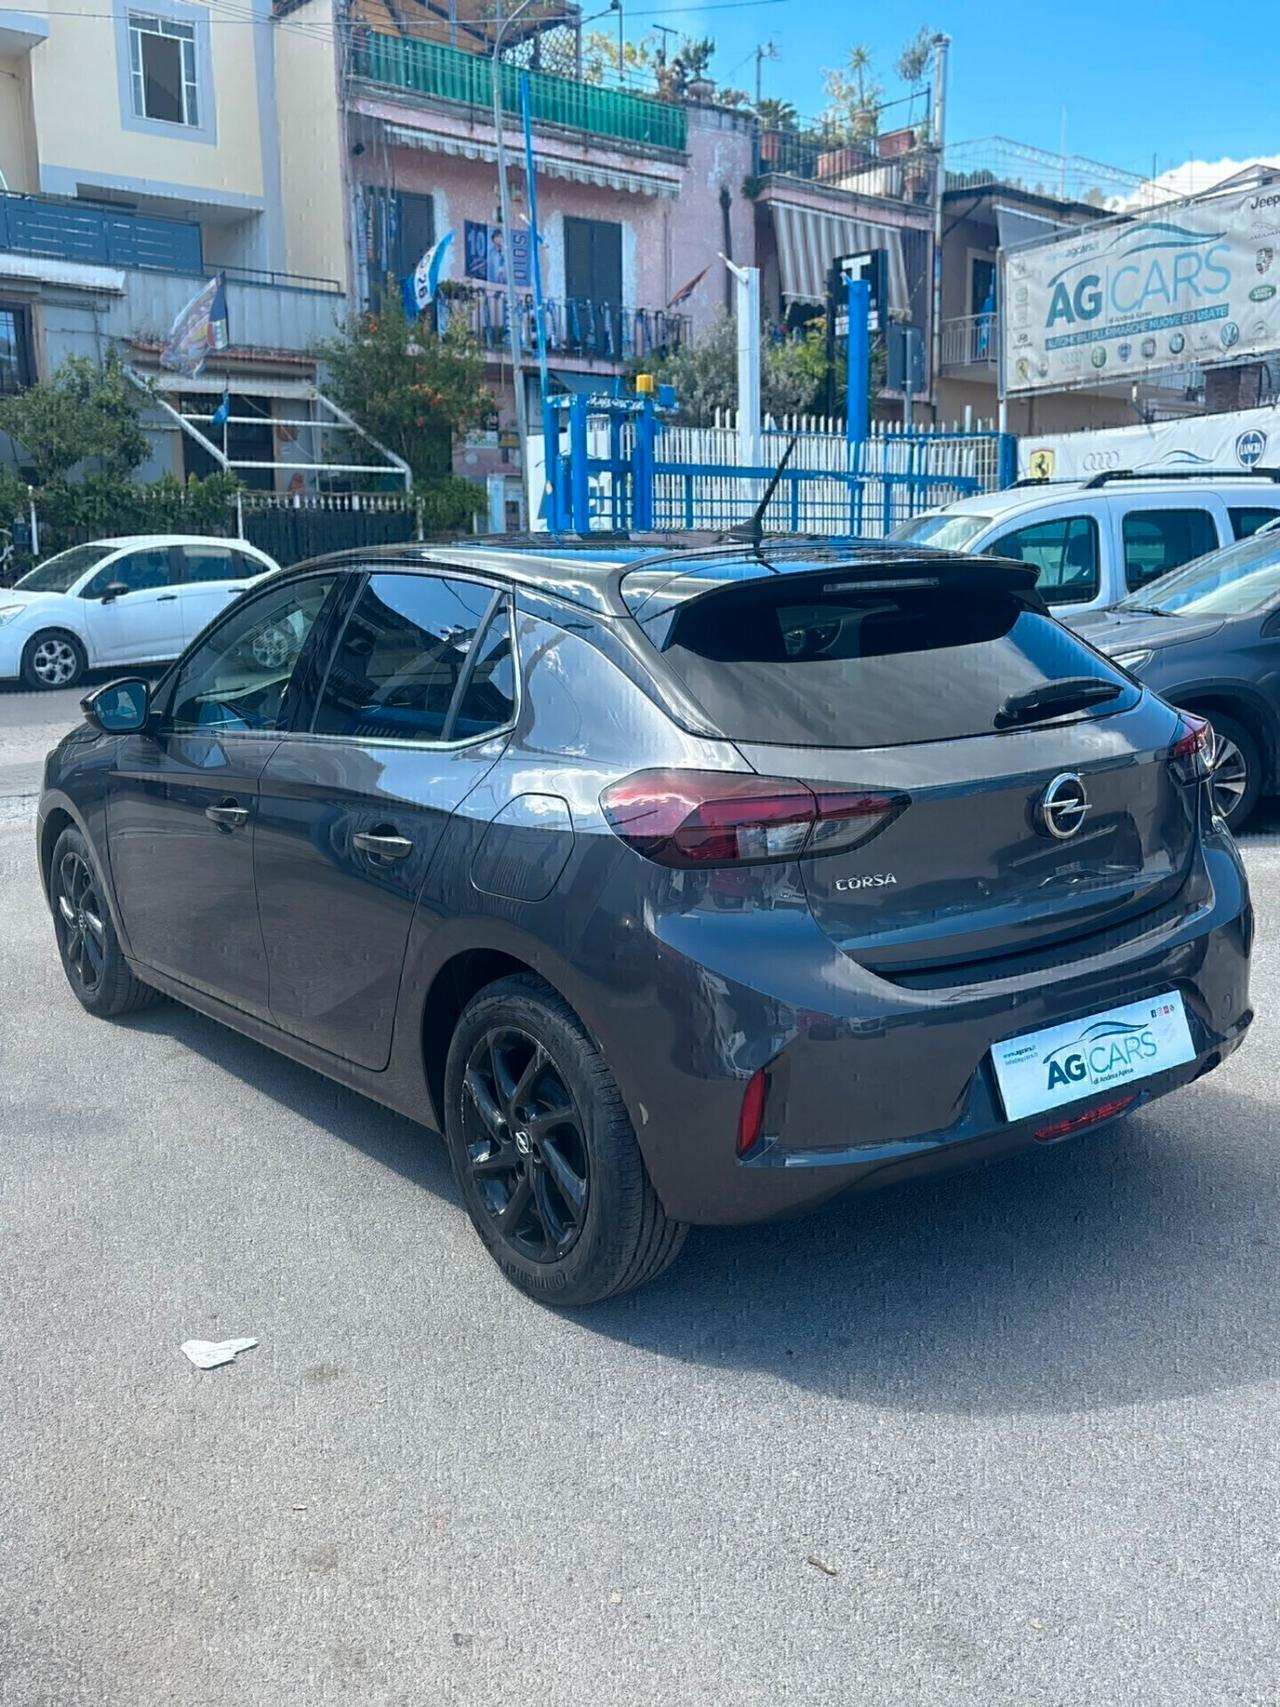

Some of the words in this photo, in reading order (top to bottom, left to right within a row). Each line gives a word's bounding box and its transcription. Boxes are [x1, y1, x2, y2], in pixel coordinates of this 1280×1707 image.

[1250, 194, 1280, 210] Jeep
[1045, 274, 1103, 328] AG
[1110, 243, 1232, 314] CARS
[1149, 314, 1181, 331] NUOVE
[1181, 312, 1196, 323] ED
[1196, 306, 1228, 320] USATE
[835, 872, 897, 891] CORSA
[1047, 1053, 1088, 1090] AG
[1088, 1031, 1158, 1074] CARS
